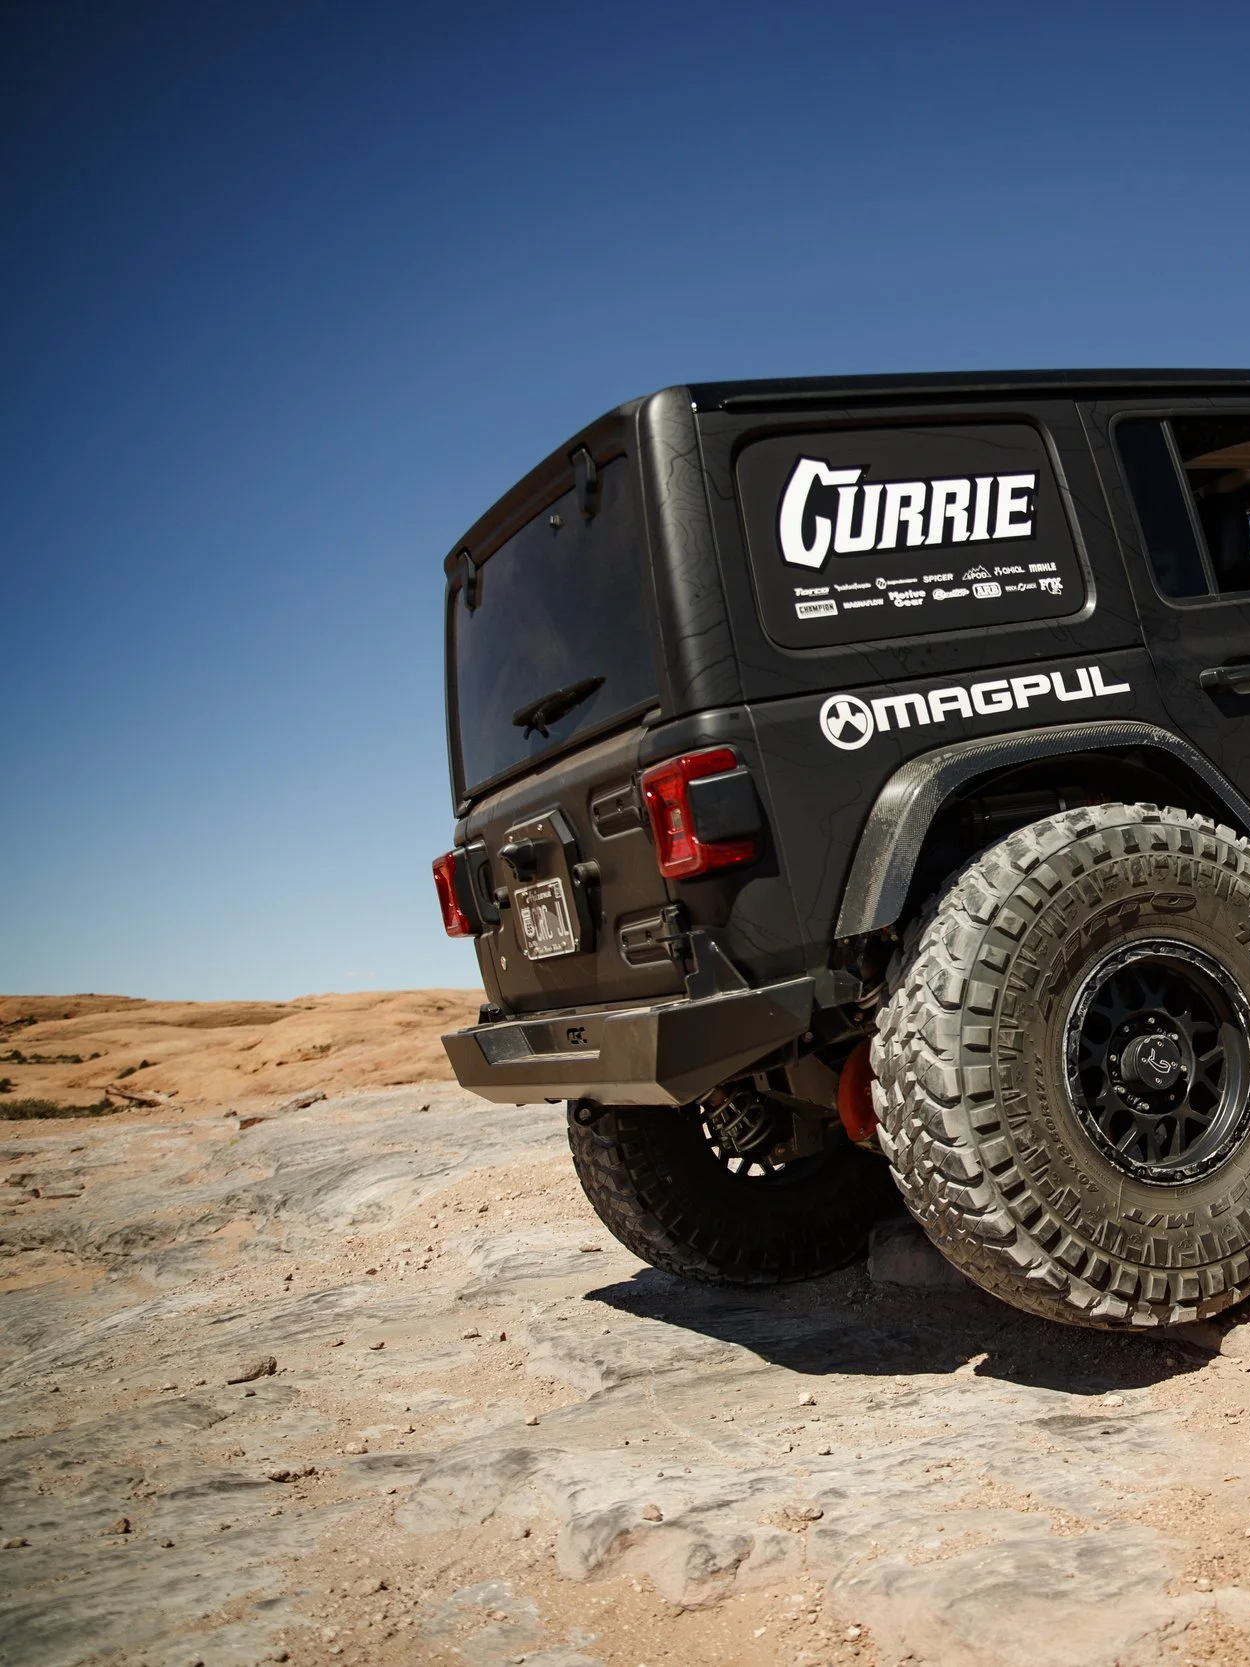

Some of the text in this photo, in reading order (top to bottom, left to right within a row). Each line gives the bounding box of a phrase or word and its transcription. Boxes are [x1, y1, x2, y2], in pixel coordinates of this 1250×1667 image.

[779, 457, 1037, 569] CURRIE
[1028, 562, 1057, 573] MAHLE
[922, 573, 954, 584] SPICER
[1038, 577, 1064, 595] FOX
[976, 584, 1000, 597] ARB
[799, 603, 835, 615] CHAMPION
[870, 665, 1131, 732] MAGPUL
[1037, 891, 1197, 1022] NITTO
